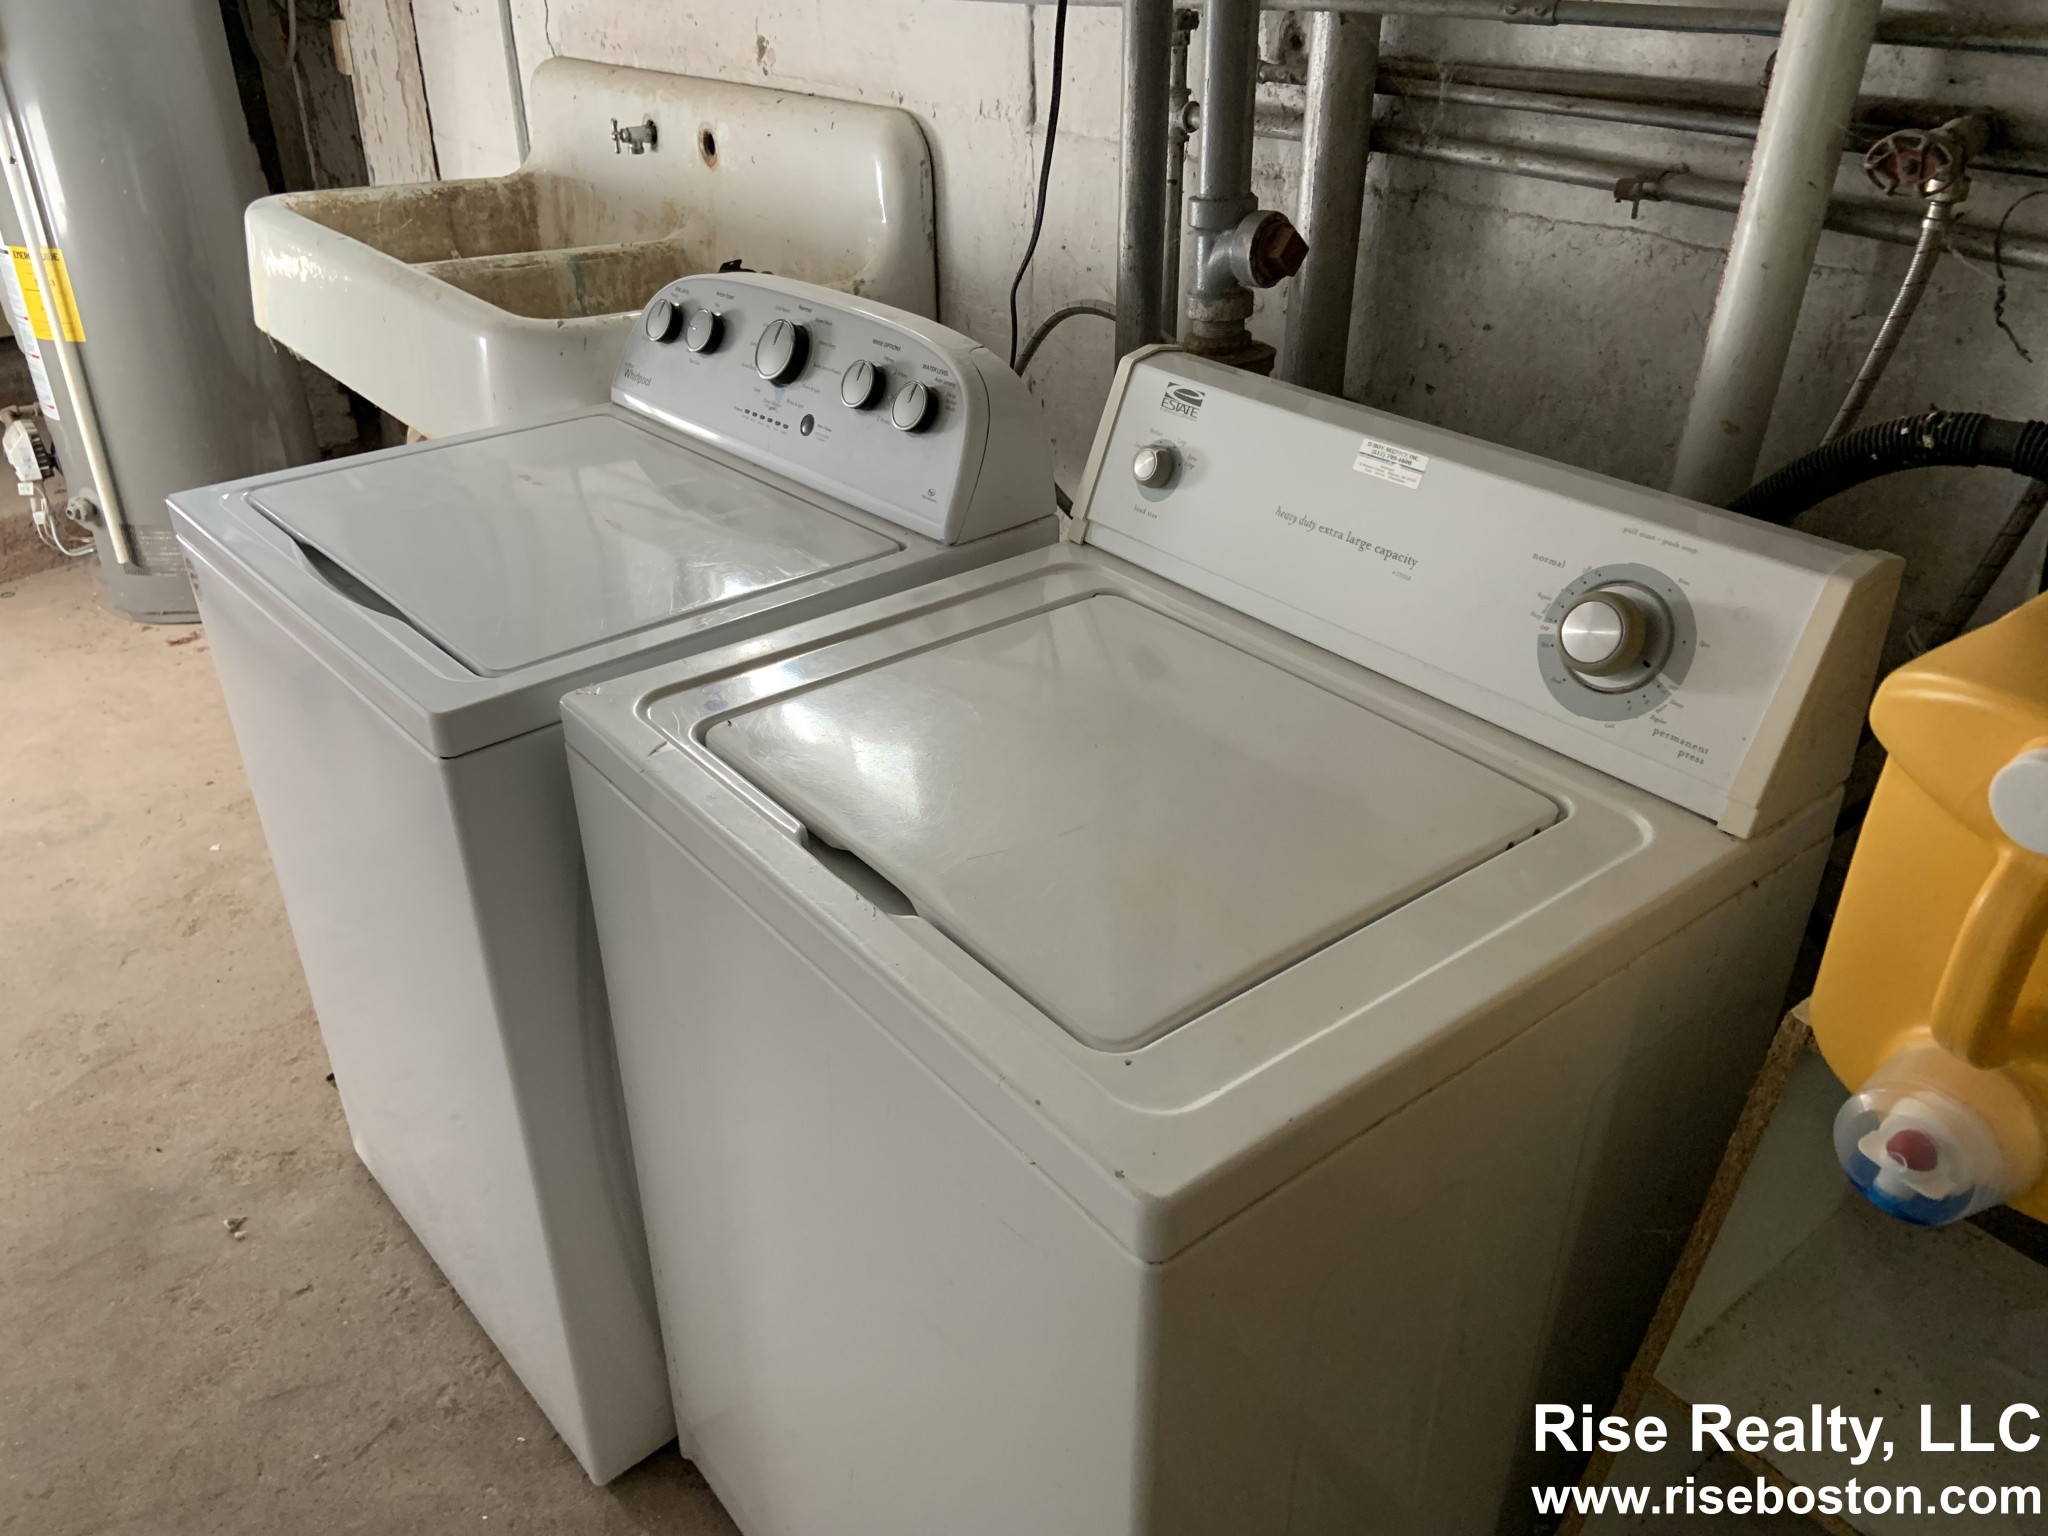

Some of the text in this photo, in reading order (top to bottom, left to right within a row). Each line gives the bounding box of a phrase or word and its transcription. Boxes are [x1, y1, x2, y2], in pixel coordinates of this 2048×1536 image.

[624, 367, 652, 387] Whirlpool
[1161, 397, 1200, 419] ESTATE
[1133, 504, 1158, 519] load size
[1275, 505, 1419, 570] heavy duty extra large capacity
[1532, 553, 1567, 569] normal
[1651, 728, 1709, 755] permanent
[1677, 750, 1705, 765] press
